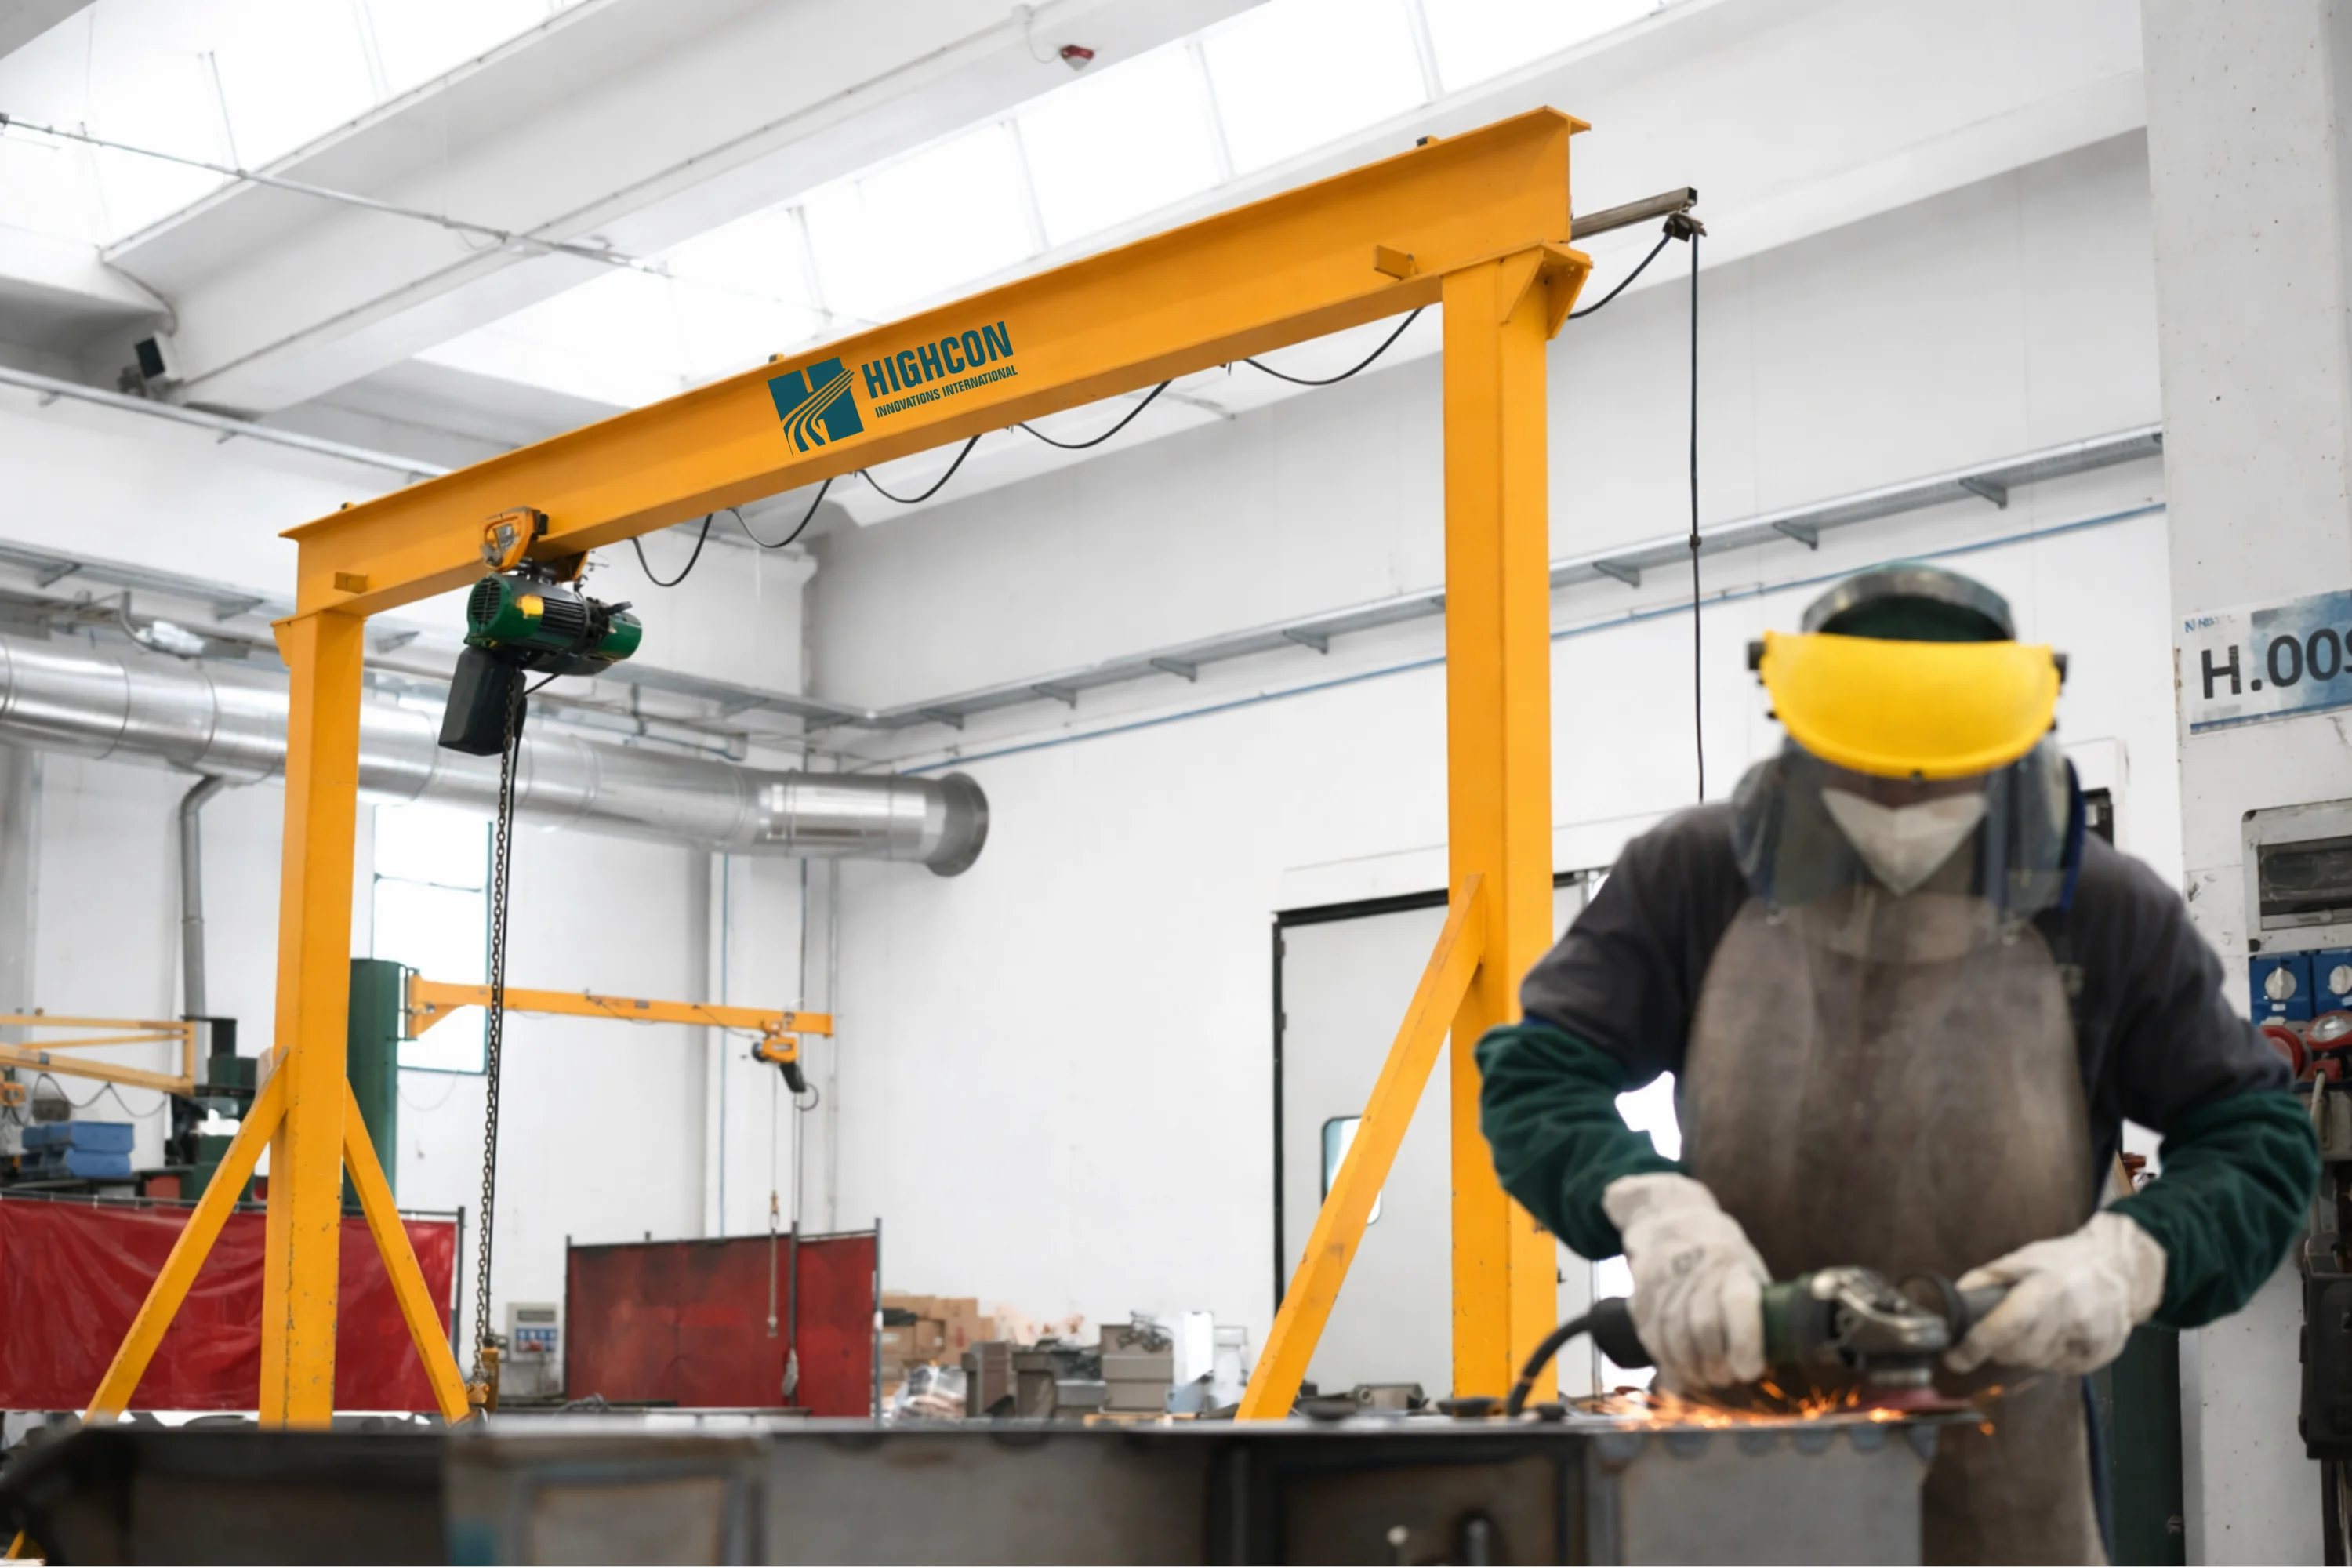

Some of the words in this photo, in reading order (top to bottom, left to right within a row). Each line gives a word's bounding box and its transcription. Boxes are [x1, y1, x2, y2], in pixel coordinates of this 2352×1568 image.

[861, 321, 1014, 399] HIGHCON
[874, 388, 941, 418] INNOVATIONS
[942, 365, 1018, 397] INTERNATIONAL
[2201, 628, 2352, 699] H.00
